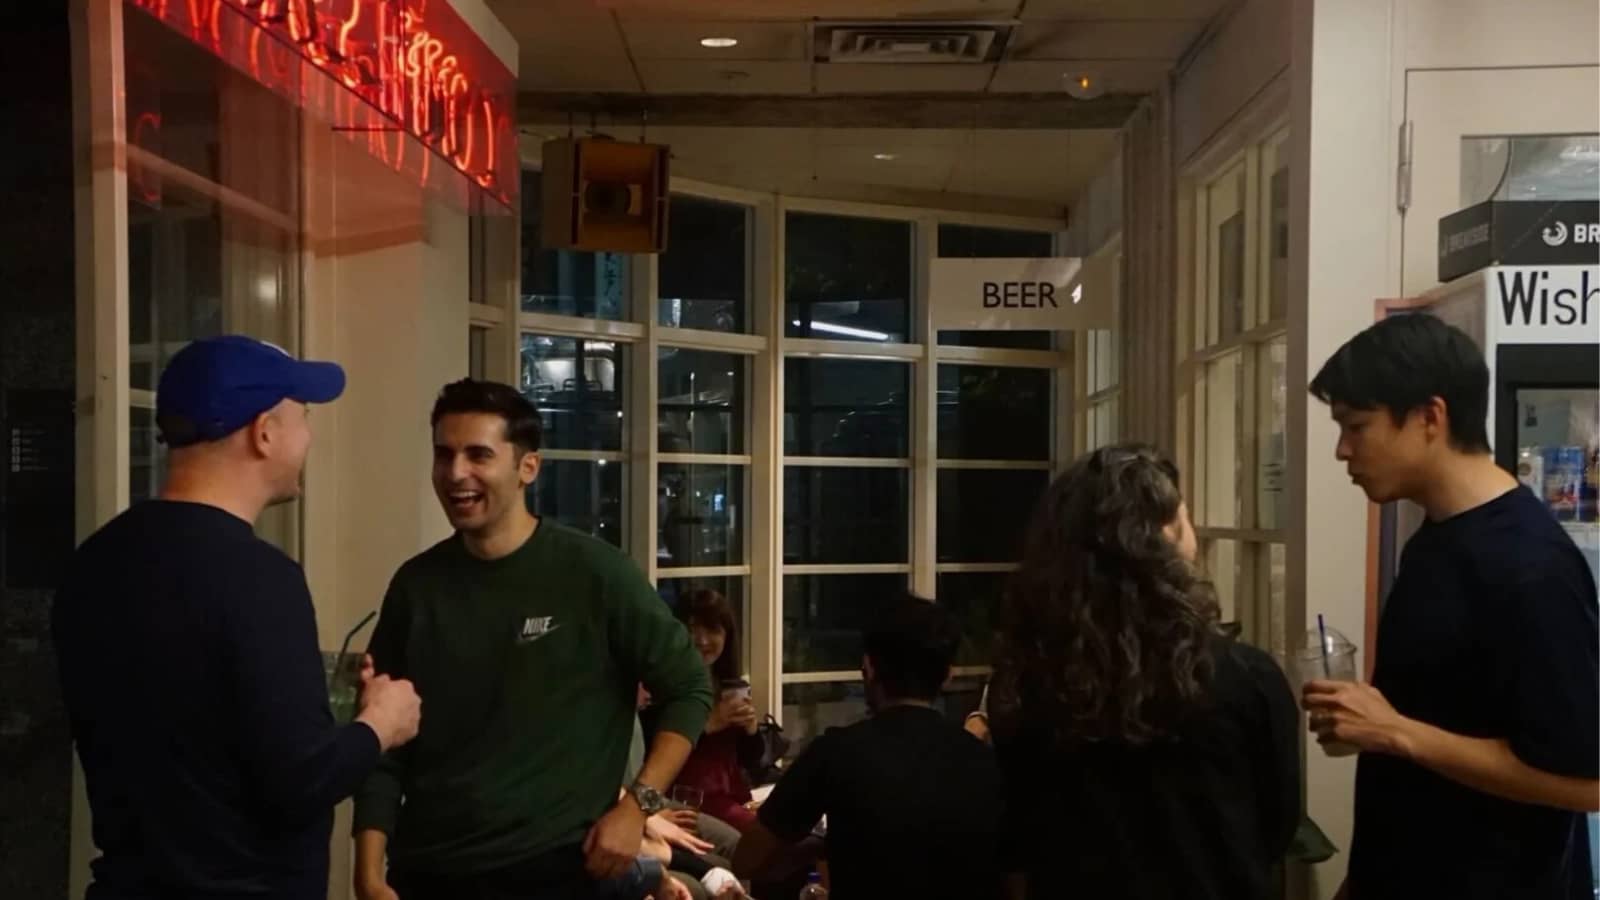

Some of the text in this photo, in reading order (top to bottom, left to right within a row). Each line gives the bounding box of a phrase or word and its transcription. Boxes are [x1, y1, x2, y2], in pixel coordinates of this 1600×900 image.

[983, 281, 1058, 309] BEER
[1497, 270, 1600, 326] Wish
[522, 615, 554, 635] NIKE
